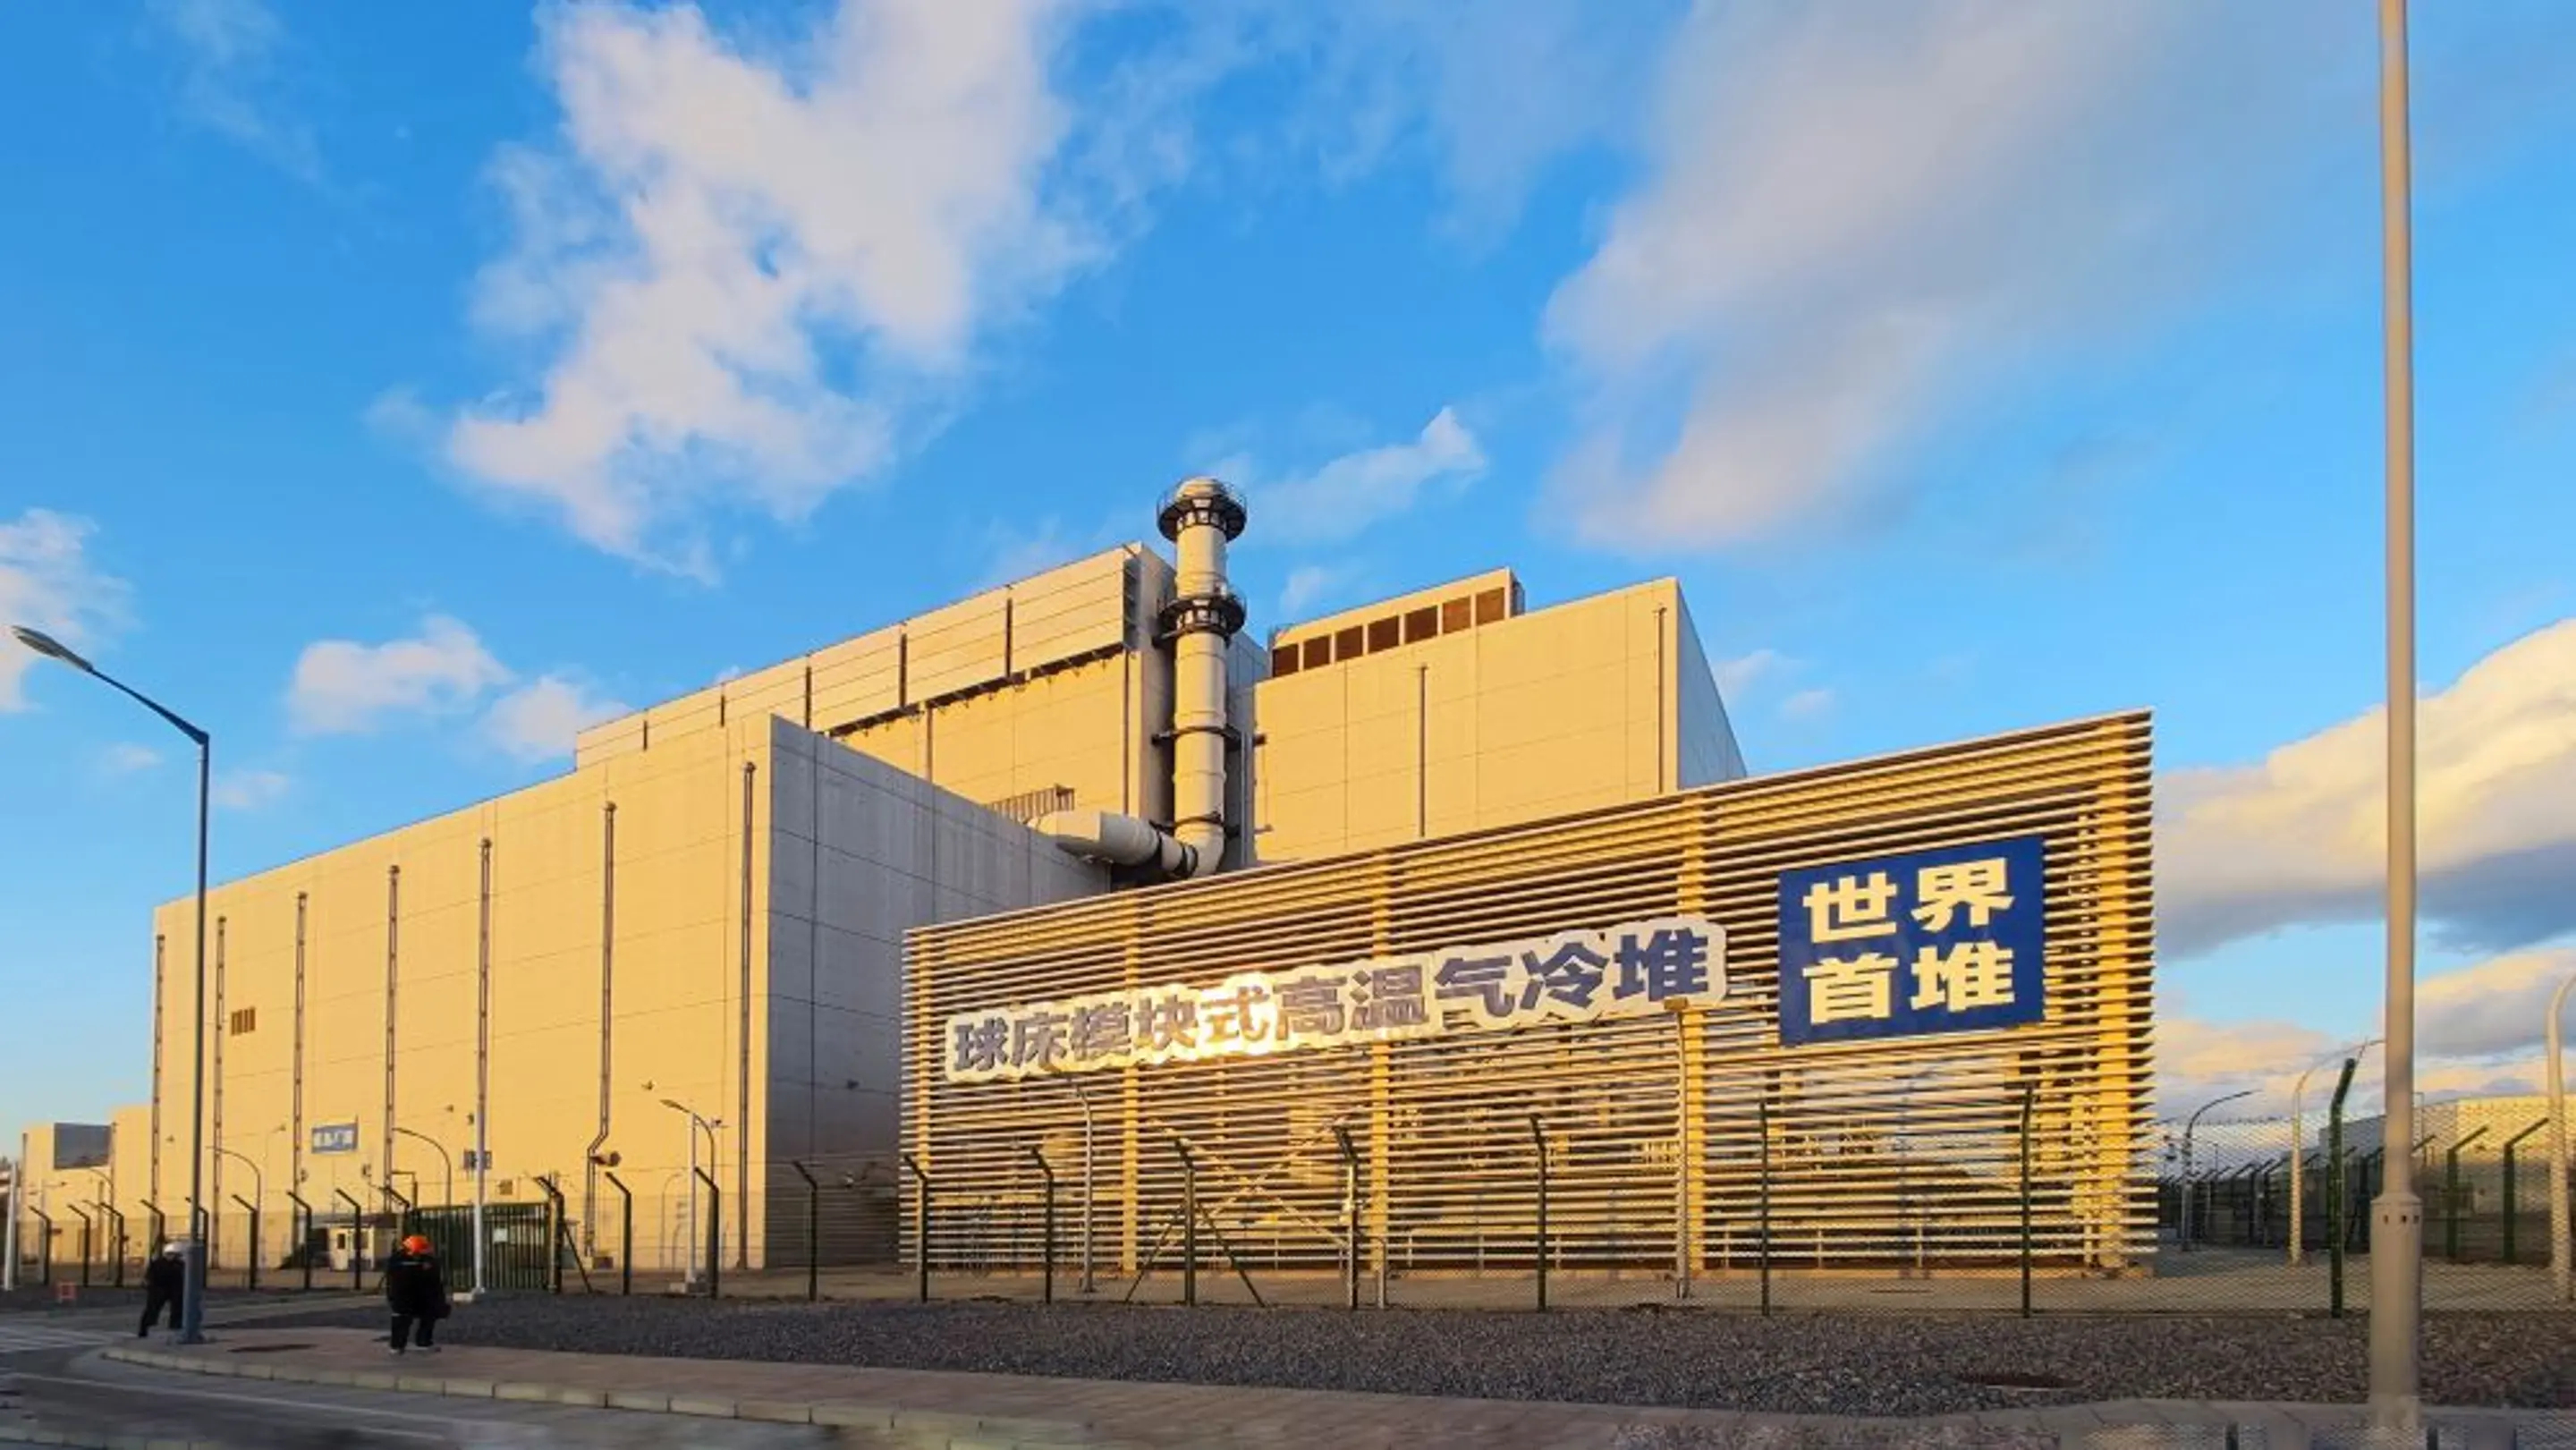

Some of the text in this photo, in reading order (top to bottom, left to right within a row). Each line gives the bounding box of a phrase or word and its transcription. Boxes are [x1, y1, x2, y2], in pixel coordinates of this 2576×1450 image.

[1801, 856, 2015, 944] 世界
[954, 928, 1709, 1072] 球床模块式高温气冷堆
[1801, 939, 2015, 1025] 首堆
